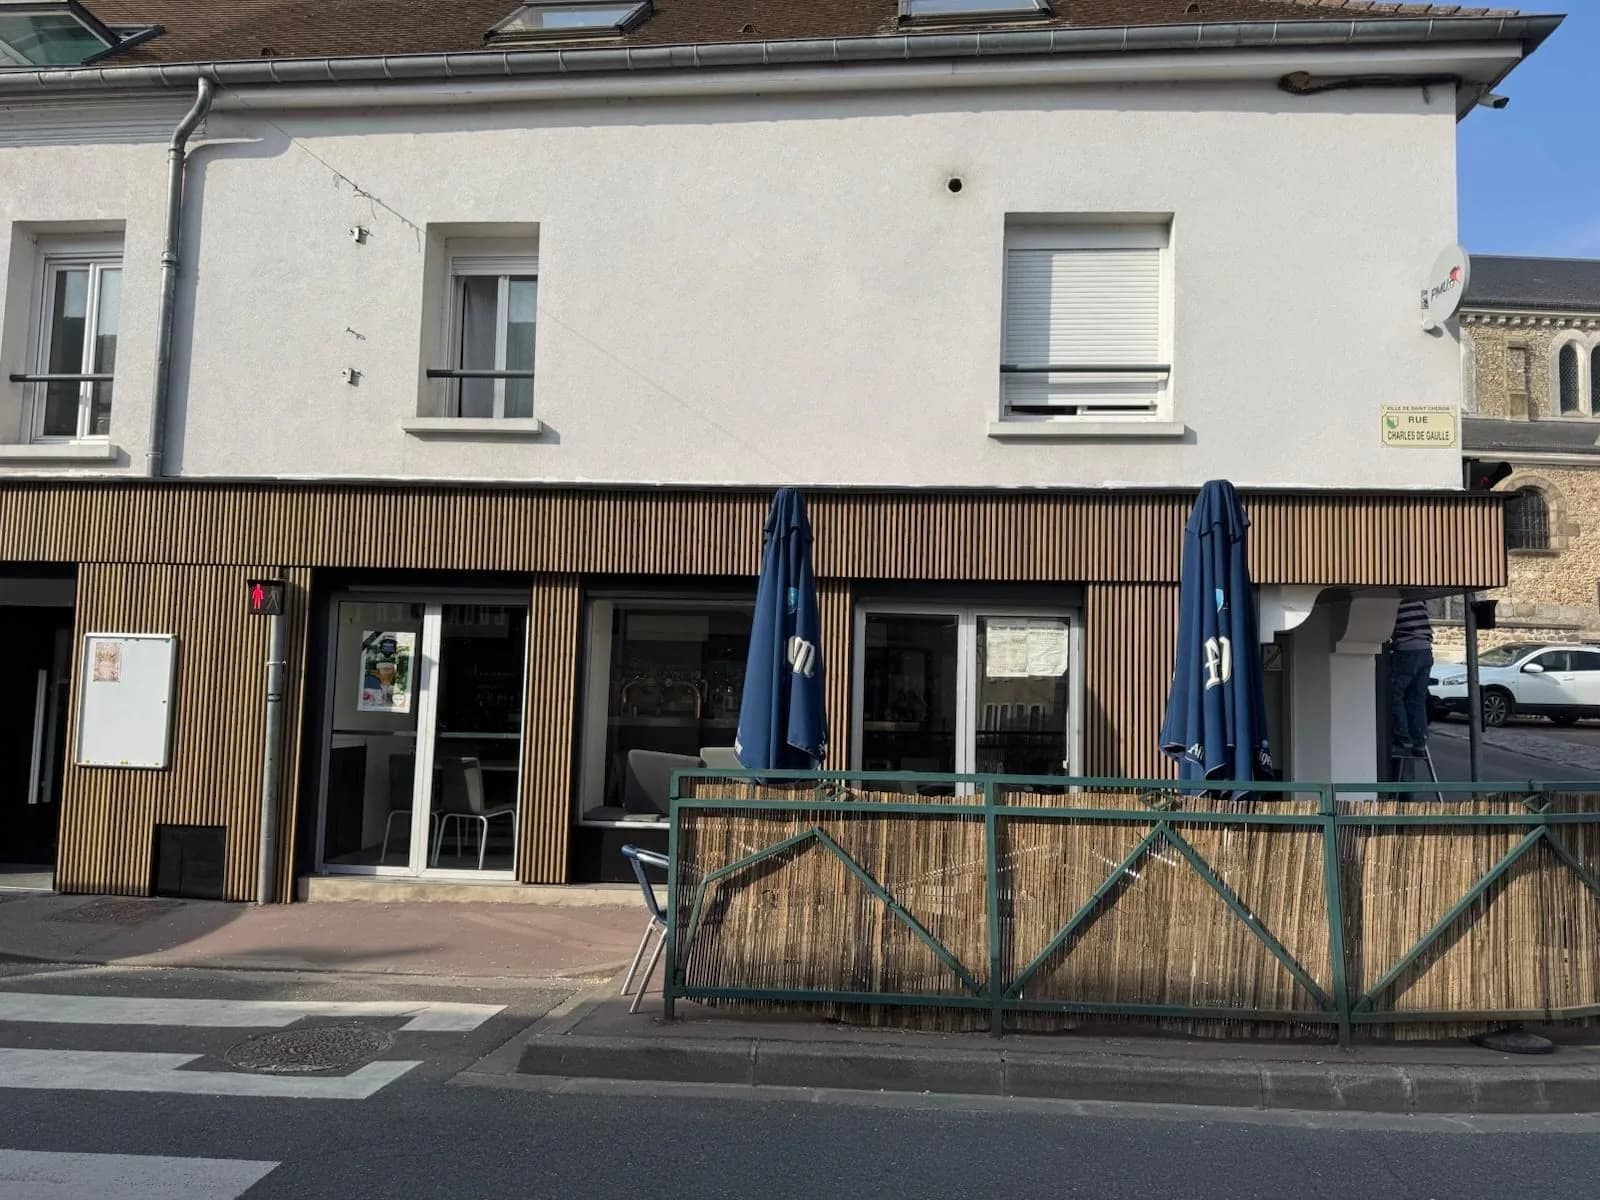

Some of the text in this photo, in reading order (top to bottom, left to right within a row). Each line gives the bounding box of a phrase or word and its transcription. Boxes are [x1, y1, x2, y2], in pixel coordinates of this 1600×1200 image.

[1408, 416, 1428, 424] RUE
[1387, 430, 1449, 441] CHARLES DE GAULLE
